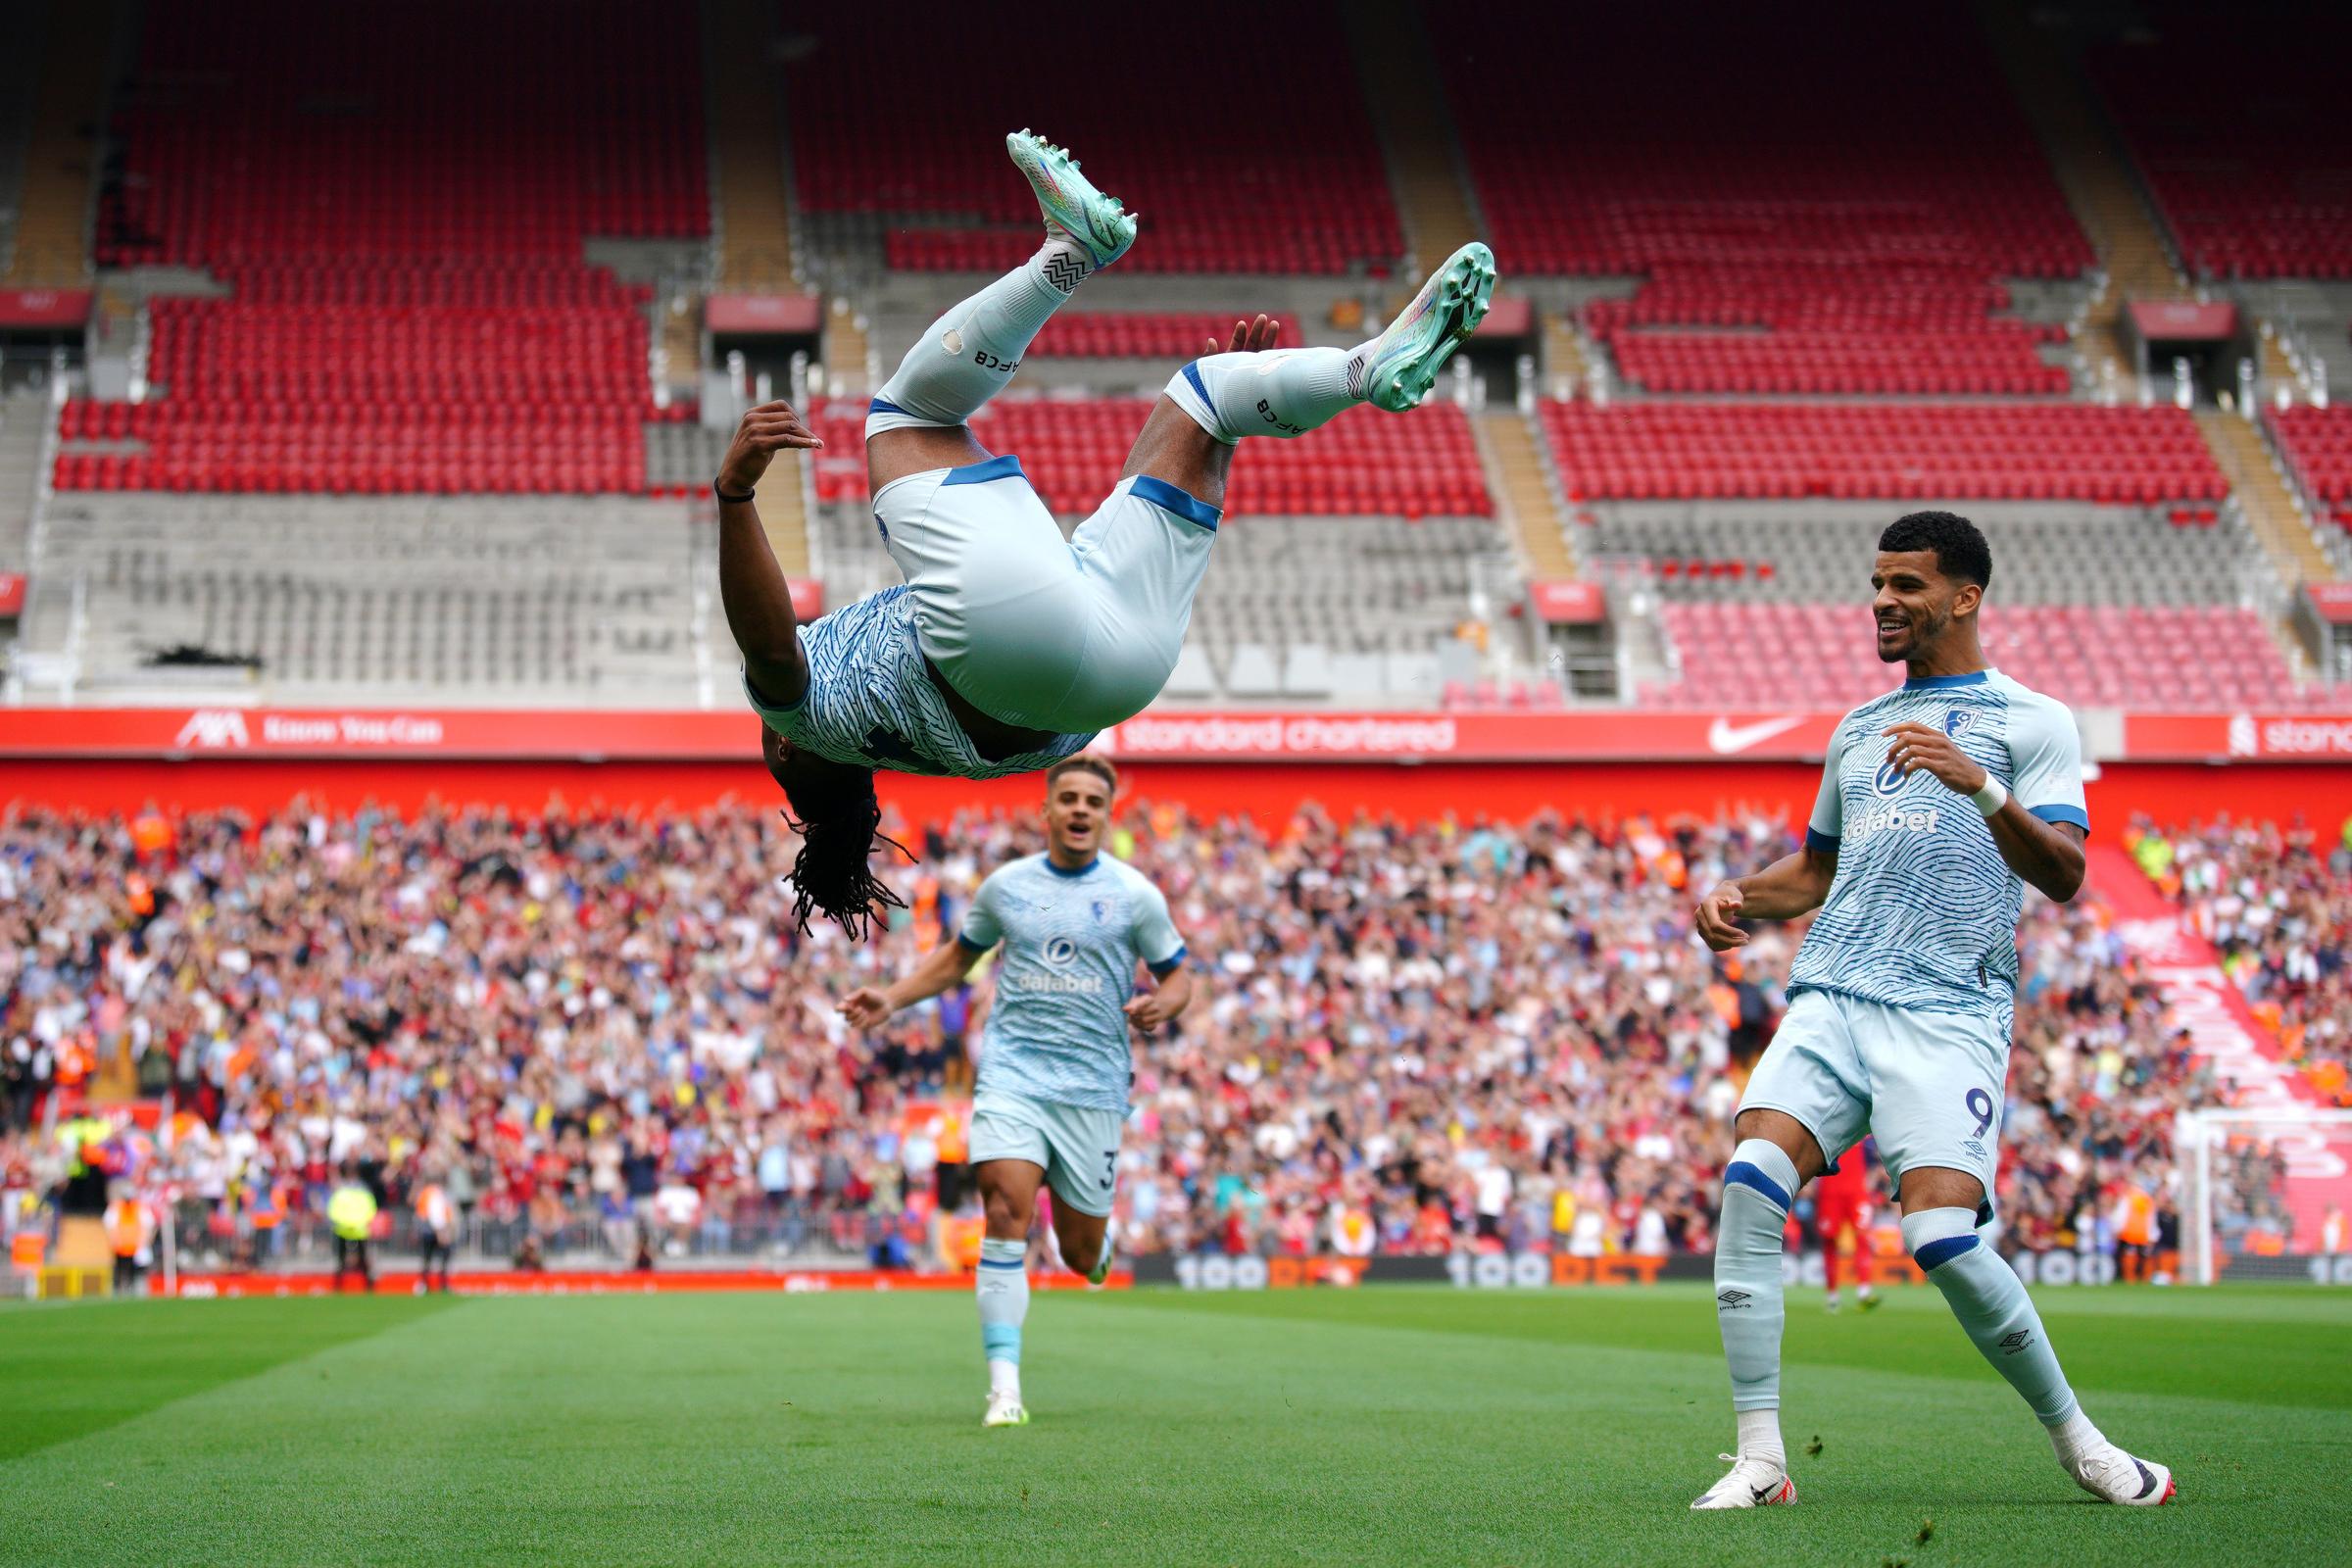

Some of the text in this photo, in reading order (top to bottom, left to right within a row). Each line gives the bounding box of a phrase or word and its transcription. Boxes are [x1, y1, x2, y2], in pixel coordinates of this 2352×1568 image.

[1256, 398, 1307, 434] AFCB
[1121, 717, 1456, 752] standard chartered
[1965, 1088, 1993, 1141] 9
[1100, 1151, 1115, 1190] 3
[2006, 1338, 2035, 1356] umbro
